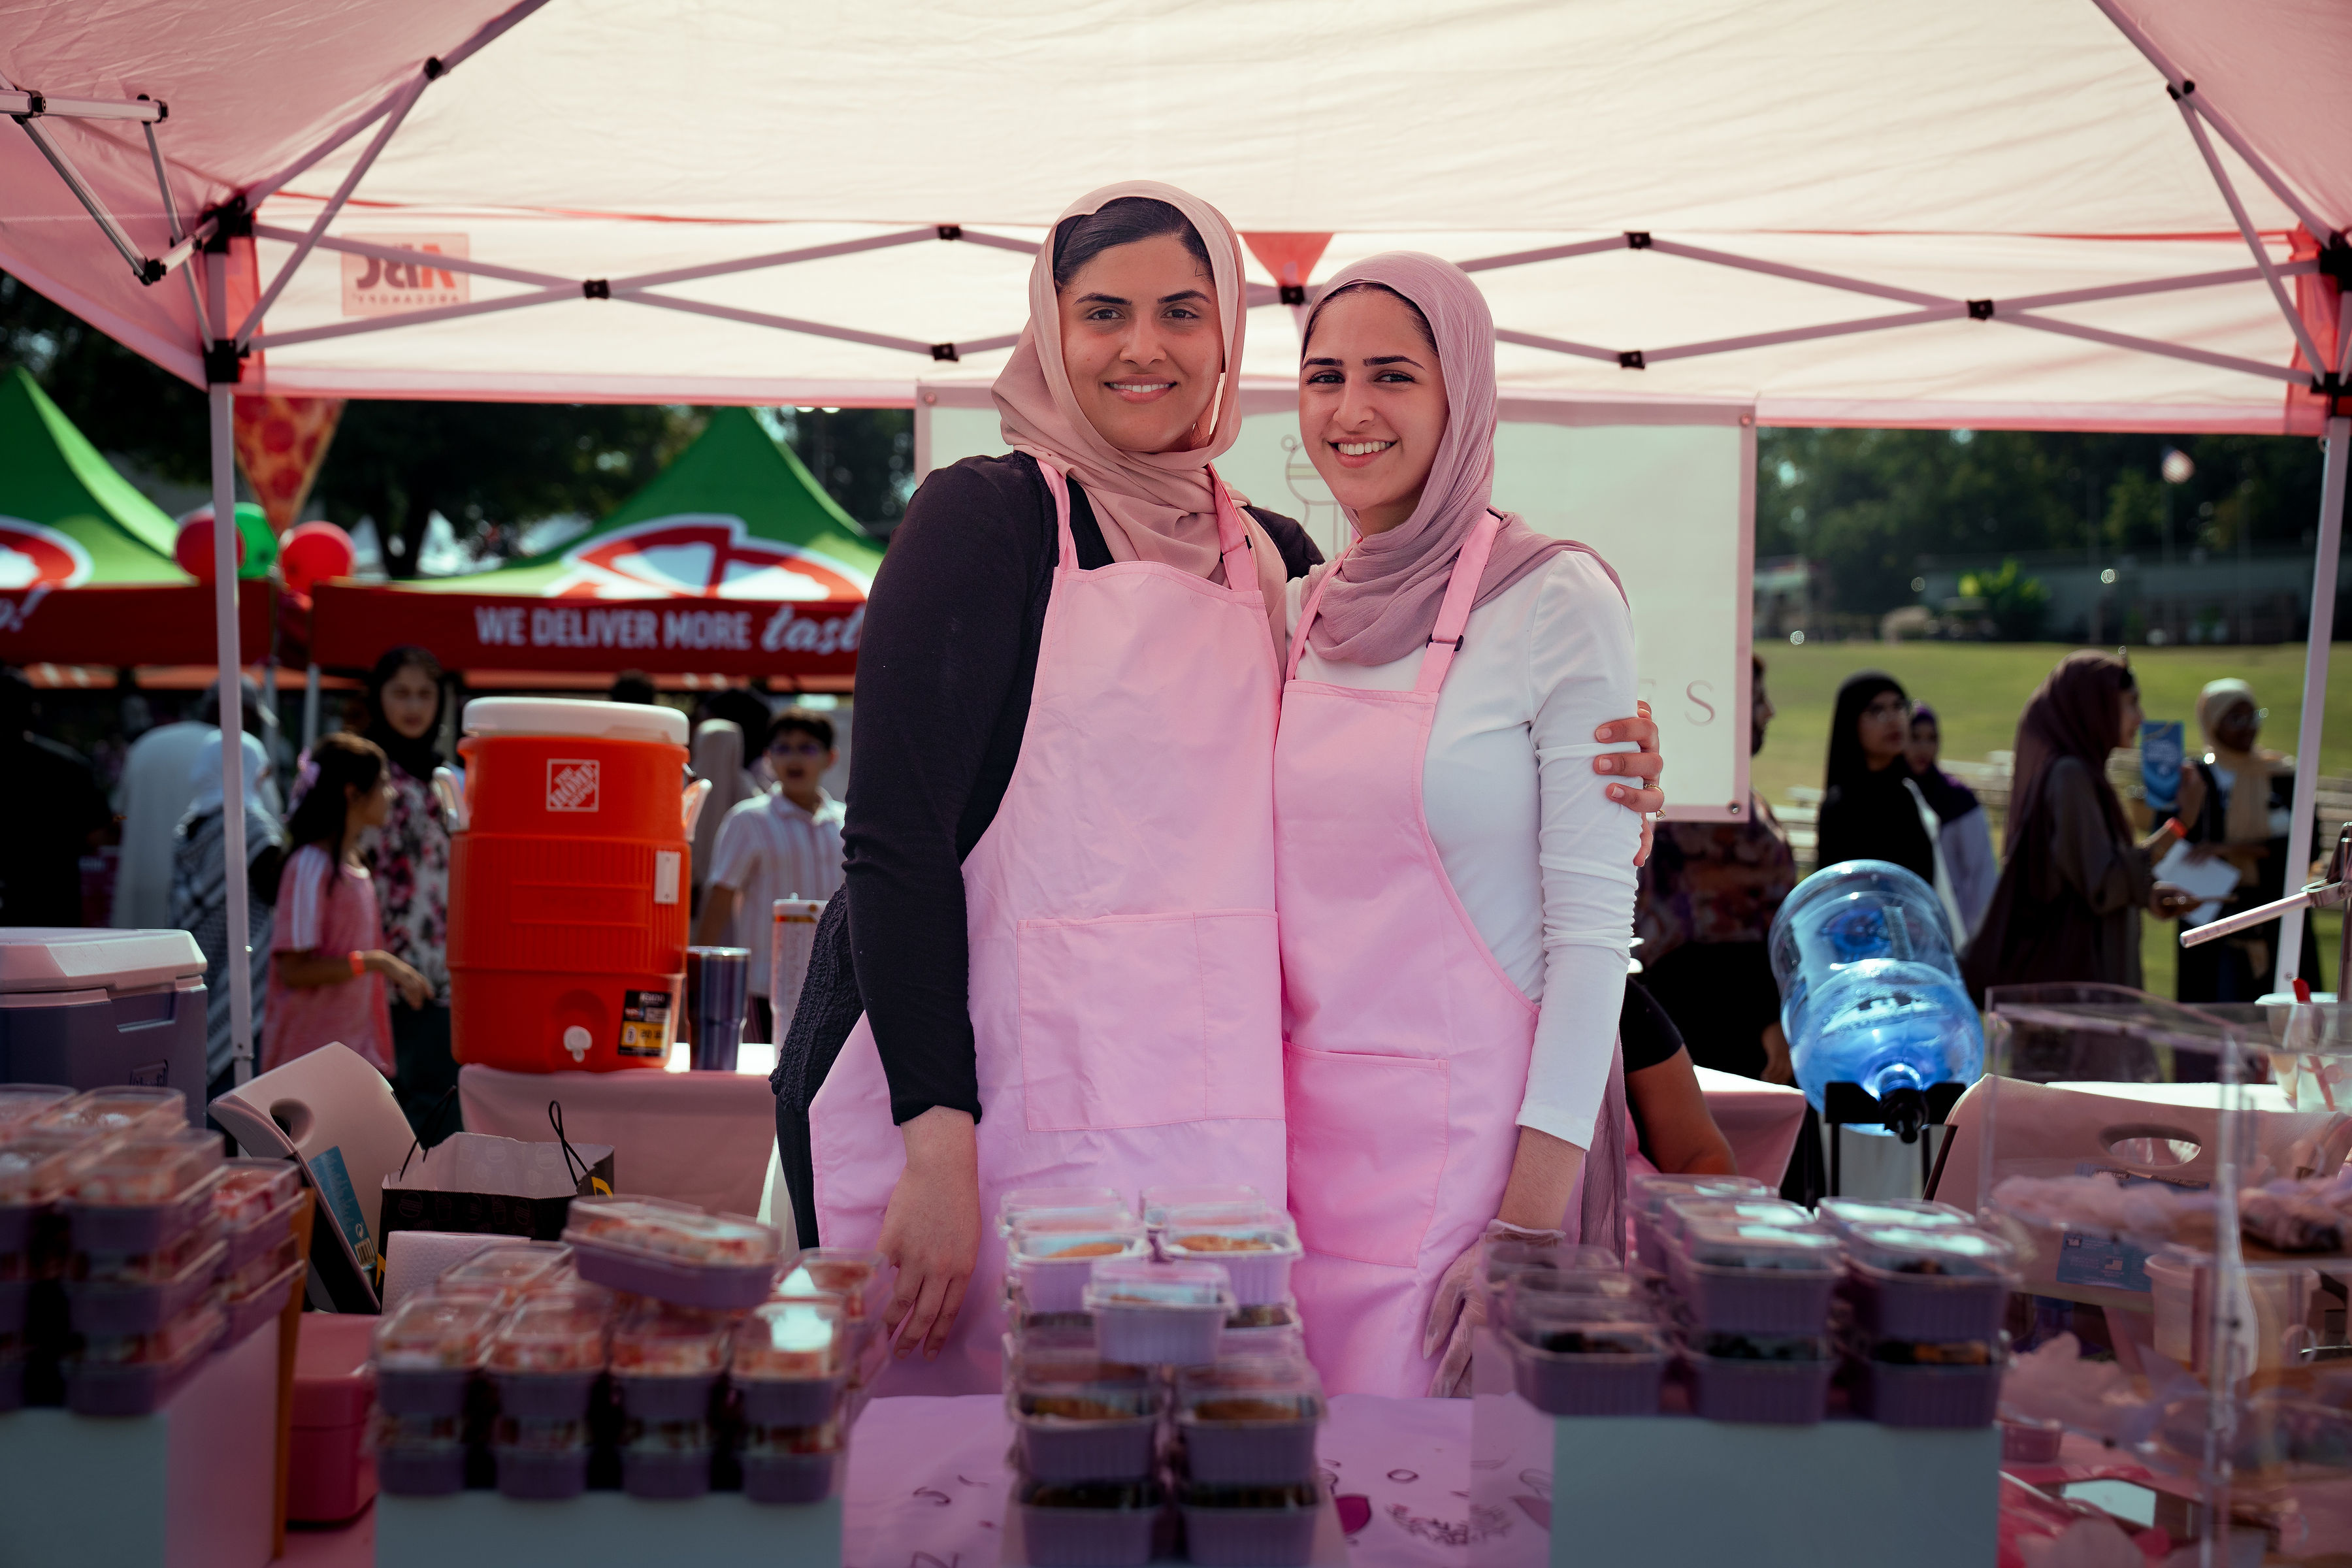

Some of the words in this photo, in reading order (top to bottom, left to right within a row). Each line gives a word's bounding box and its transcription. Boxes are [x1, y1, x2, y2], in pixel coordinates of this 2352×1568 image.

[475, 607, 525, 645] WE
[532, 608, 658, 648] DELIVER
[664, 611, 751, 650] MORE
[549, 762, 595, 809] HOME
